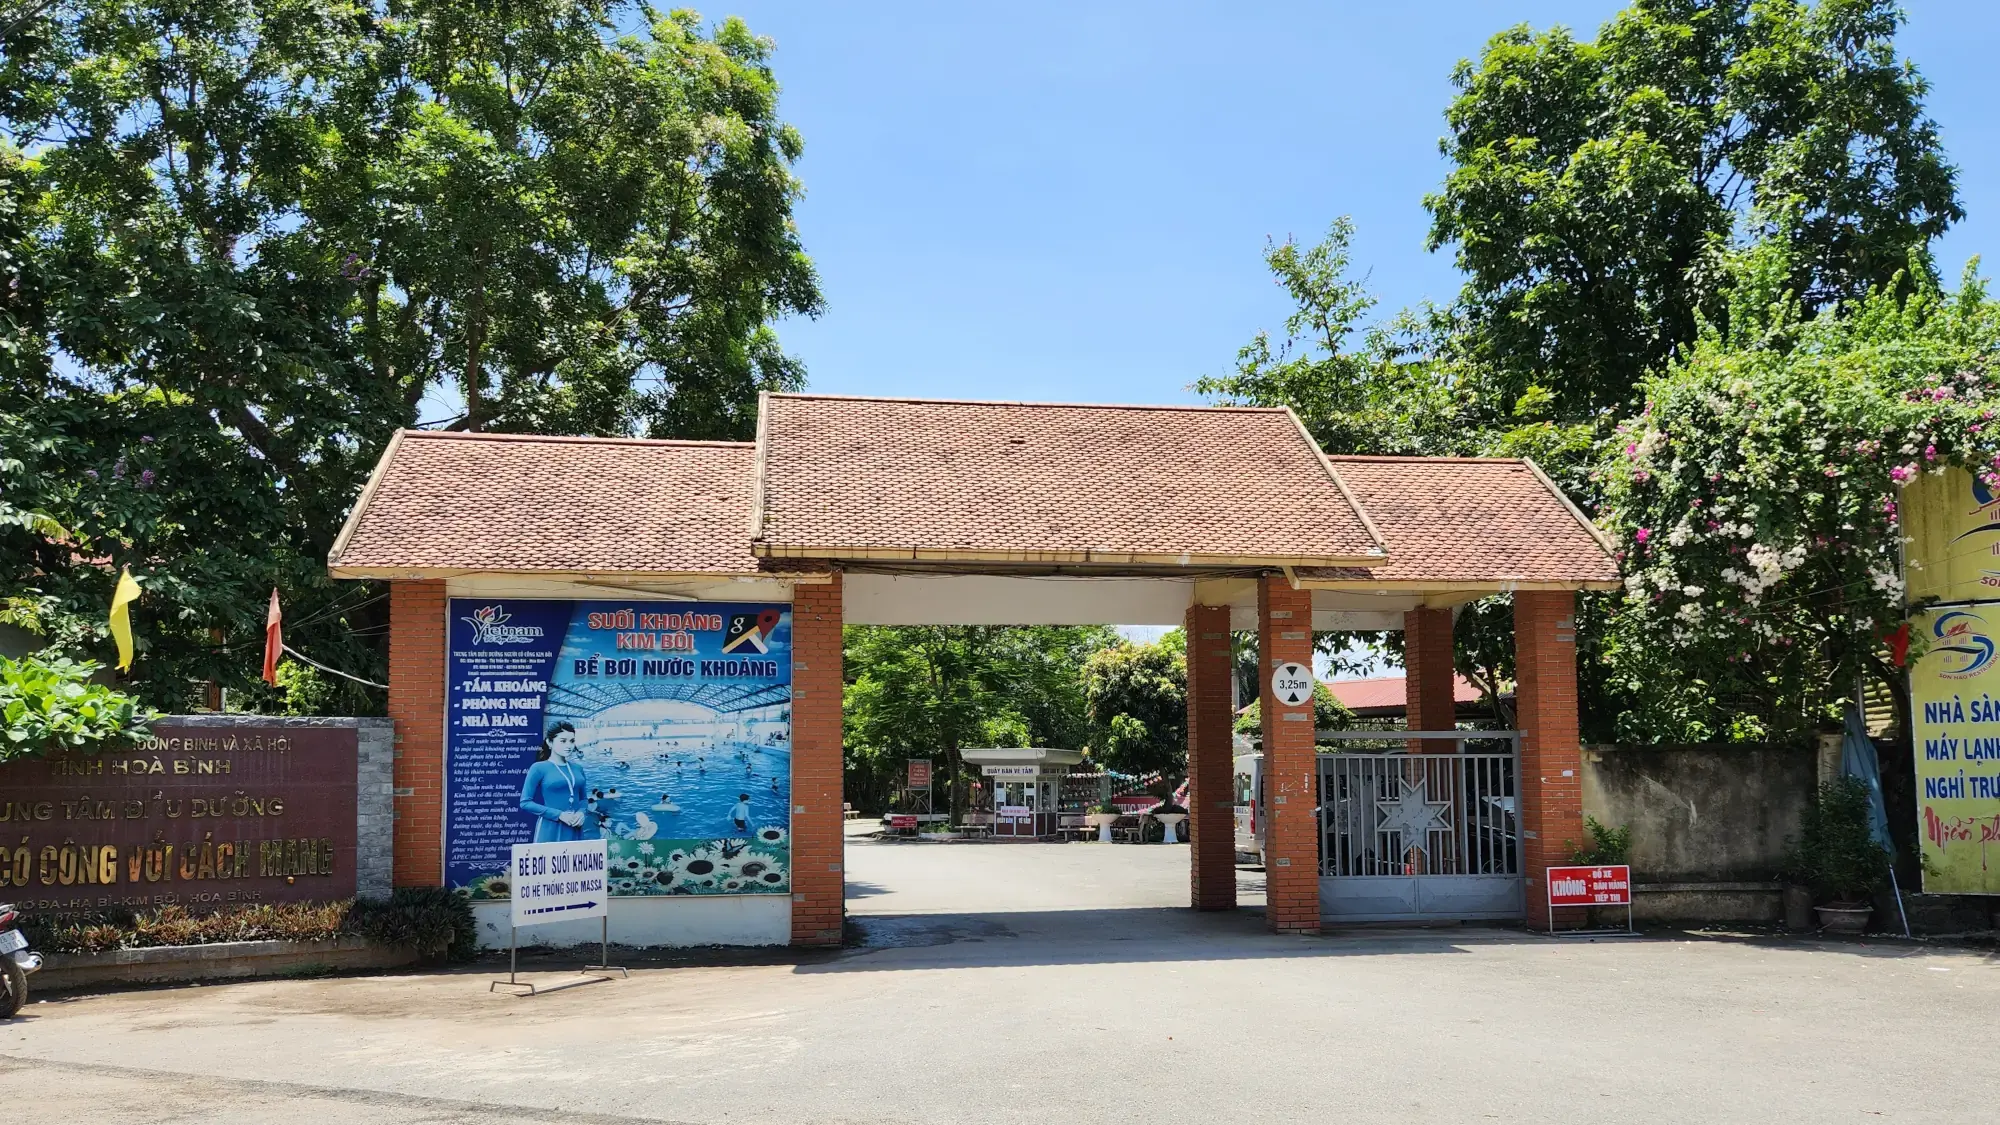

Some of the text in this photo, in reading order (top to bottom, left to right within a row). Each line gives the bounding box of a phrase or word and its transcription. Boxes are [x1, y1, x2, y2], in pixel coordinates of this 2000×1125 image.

[588, 609, 722, 630] SUỐI KHOÁNG
[616, 632, 695, 650] KIM BÔI
[574, 653, 778, 677] BỂ BƠI NƯỚC KHOÁNG
[494, 678, 547, 692] KHOÁNG
[1280, 680, 1307, 690] 3,25m
[462, 696, 507, 710] PHÒNG
[1925, 694, 1965, 724] NHÀ
[462, 713, 528, 727] NHÀ HÀNG
[184, 738, 218, 751] BINH
[222, 734, 240, 751] VÀ
[243, 735, 264, 751] XÃ
[267, 735, 291, 754] HỘI
[1925, 732, 1959, 761] MÁY
[112, 756, 165, 775] HOÀ
[173, 756, 231, 775] BÌNH
[1926, 769, 1965, 798] NGHỈ
[61, 795, 116, 820] TÂM
[40, 836, 117, 886] CÔNG
[180, 831, 250, 880] CÁCH
[259, 837, 334, 885] MẠNG
[519, 848, 604, 877] BỂ BƠI SUỐI KHOÁNG
[1603, 870, 1613, 879] XE
[521, 879, 602, 900] CÓ HỆ THỐNG SỤC MASSA
[1552, 876, 1587, 897] KHÔNG
